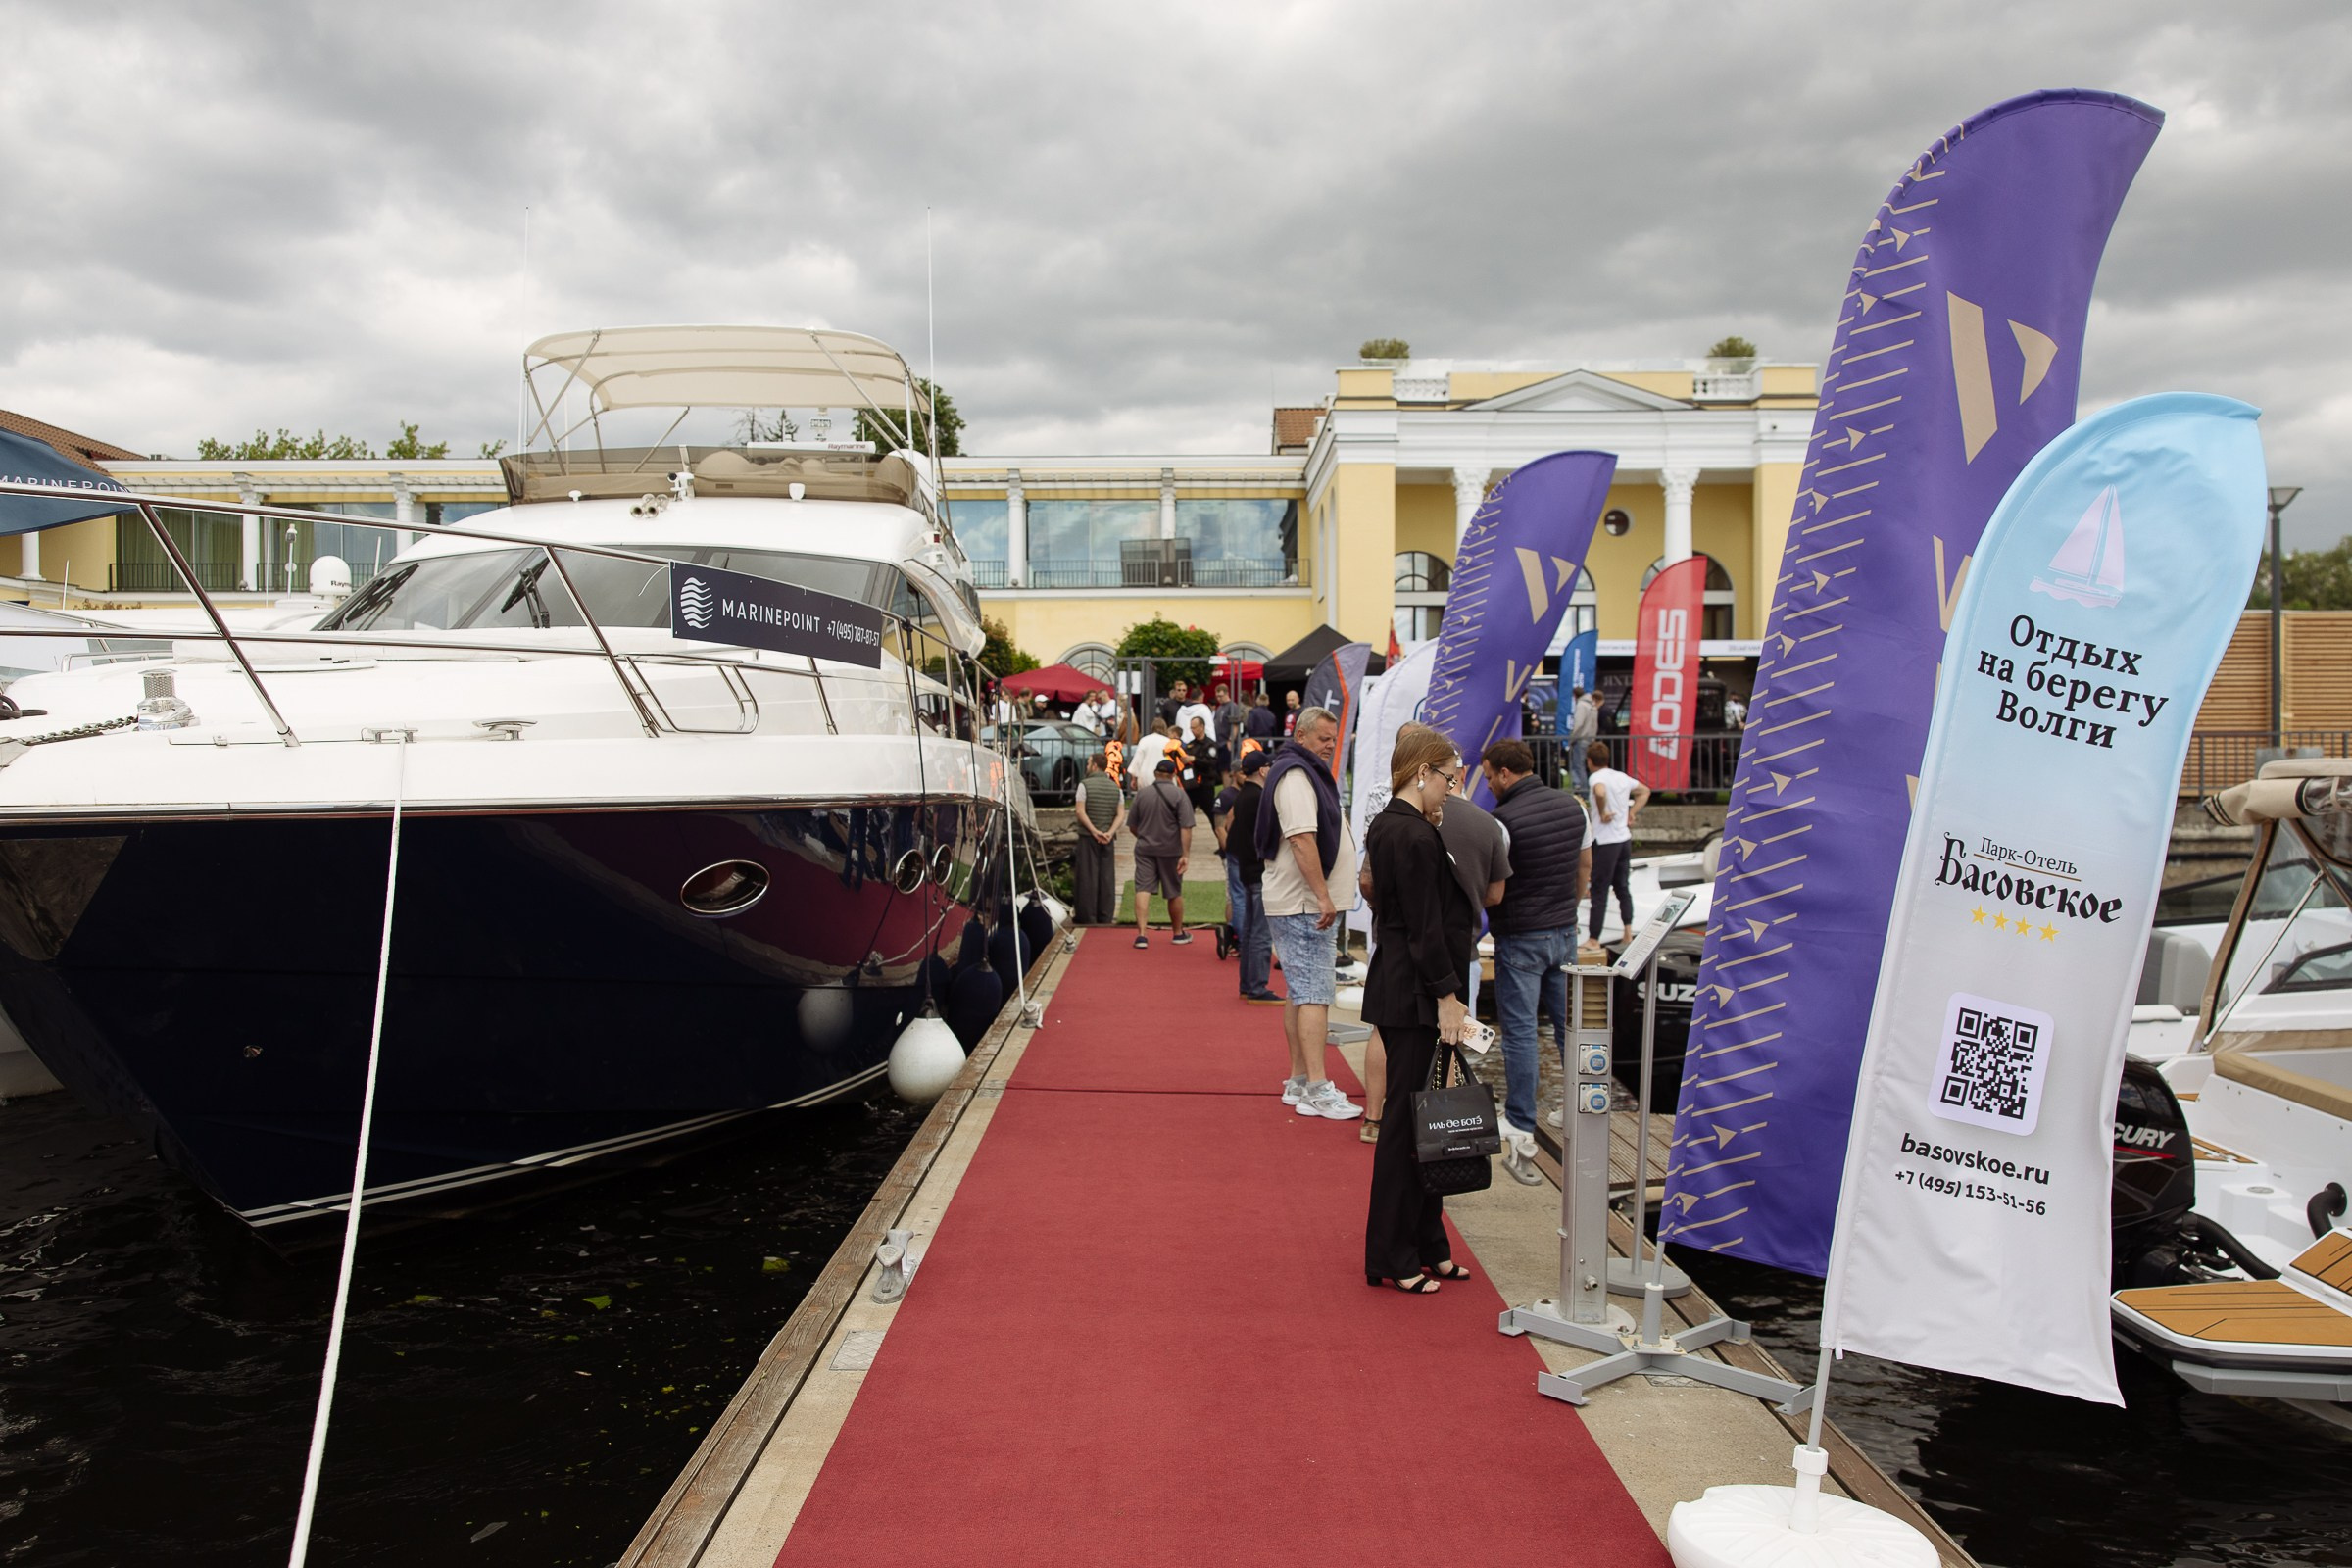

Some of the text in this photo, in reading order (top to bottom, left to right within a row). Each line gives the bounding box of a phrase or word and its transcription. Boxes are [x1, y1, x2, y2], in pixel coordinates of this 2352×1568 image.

[721, 598, 821, 634] MARINEPOINT
[826, 620, 880, 647] +7 (495) 787-87-57
[2010, 614, 2142, 676] Отдых
[1649, 608, 1688, 760] AODES
[1977, 650, 2169, 727] на берегу
[1995, 689, 2117, 749] Волги
[1935, 831, 2123, 924] Басовское
[1981, 837, 2078, 875] Парк-Отель
[1637, 981, 1696, 1002] SUZ
[1900, 1132, 2050, 1186] basovskoe.ru
[2114, 1122, 2176, 1149] CURY
[1894, 1170, 2046, 1216] +7 (495) 153-51-56
